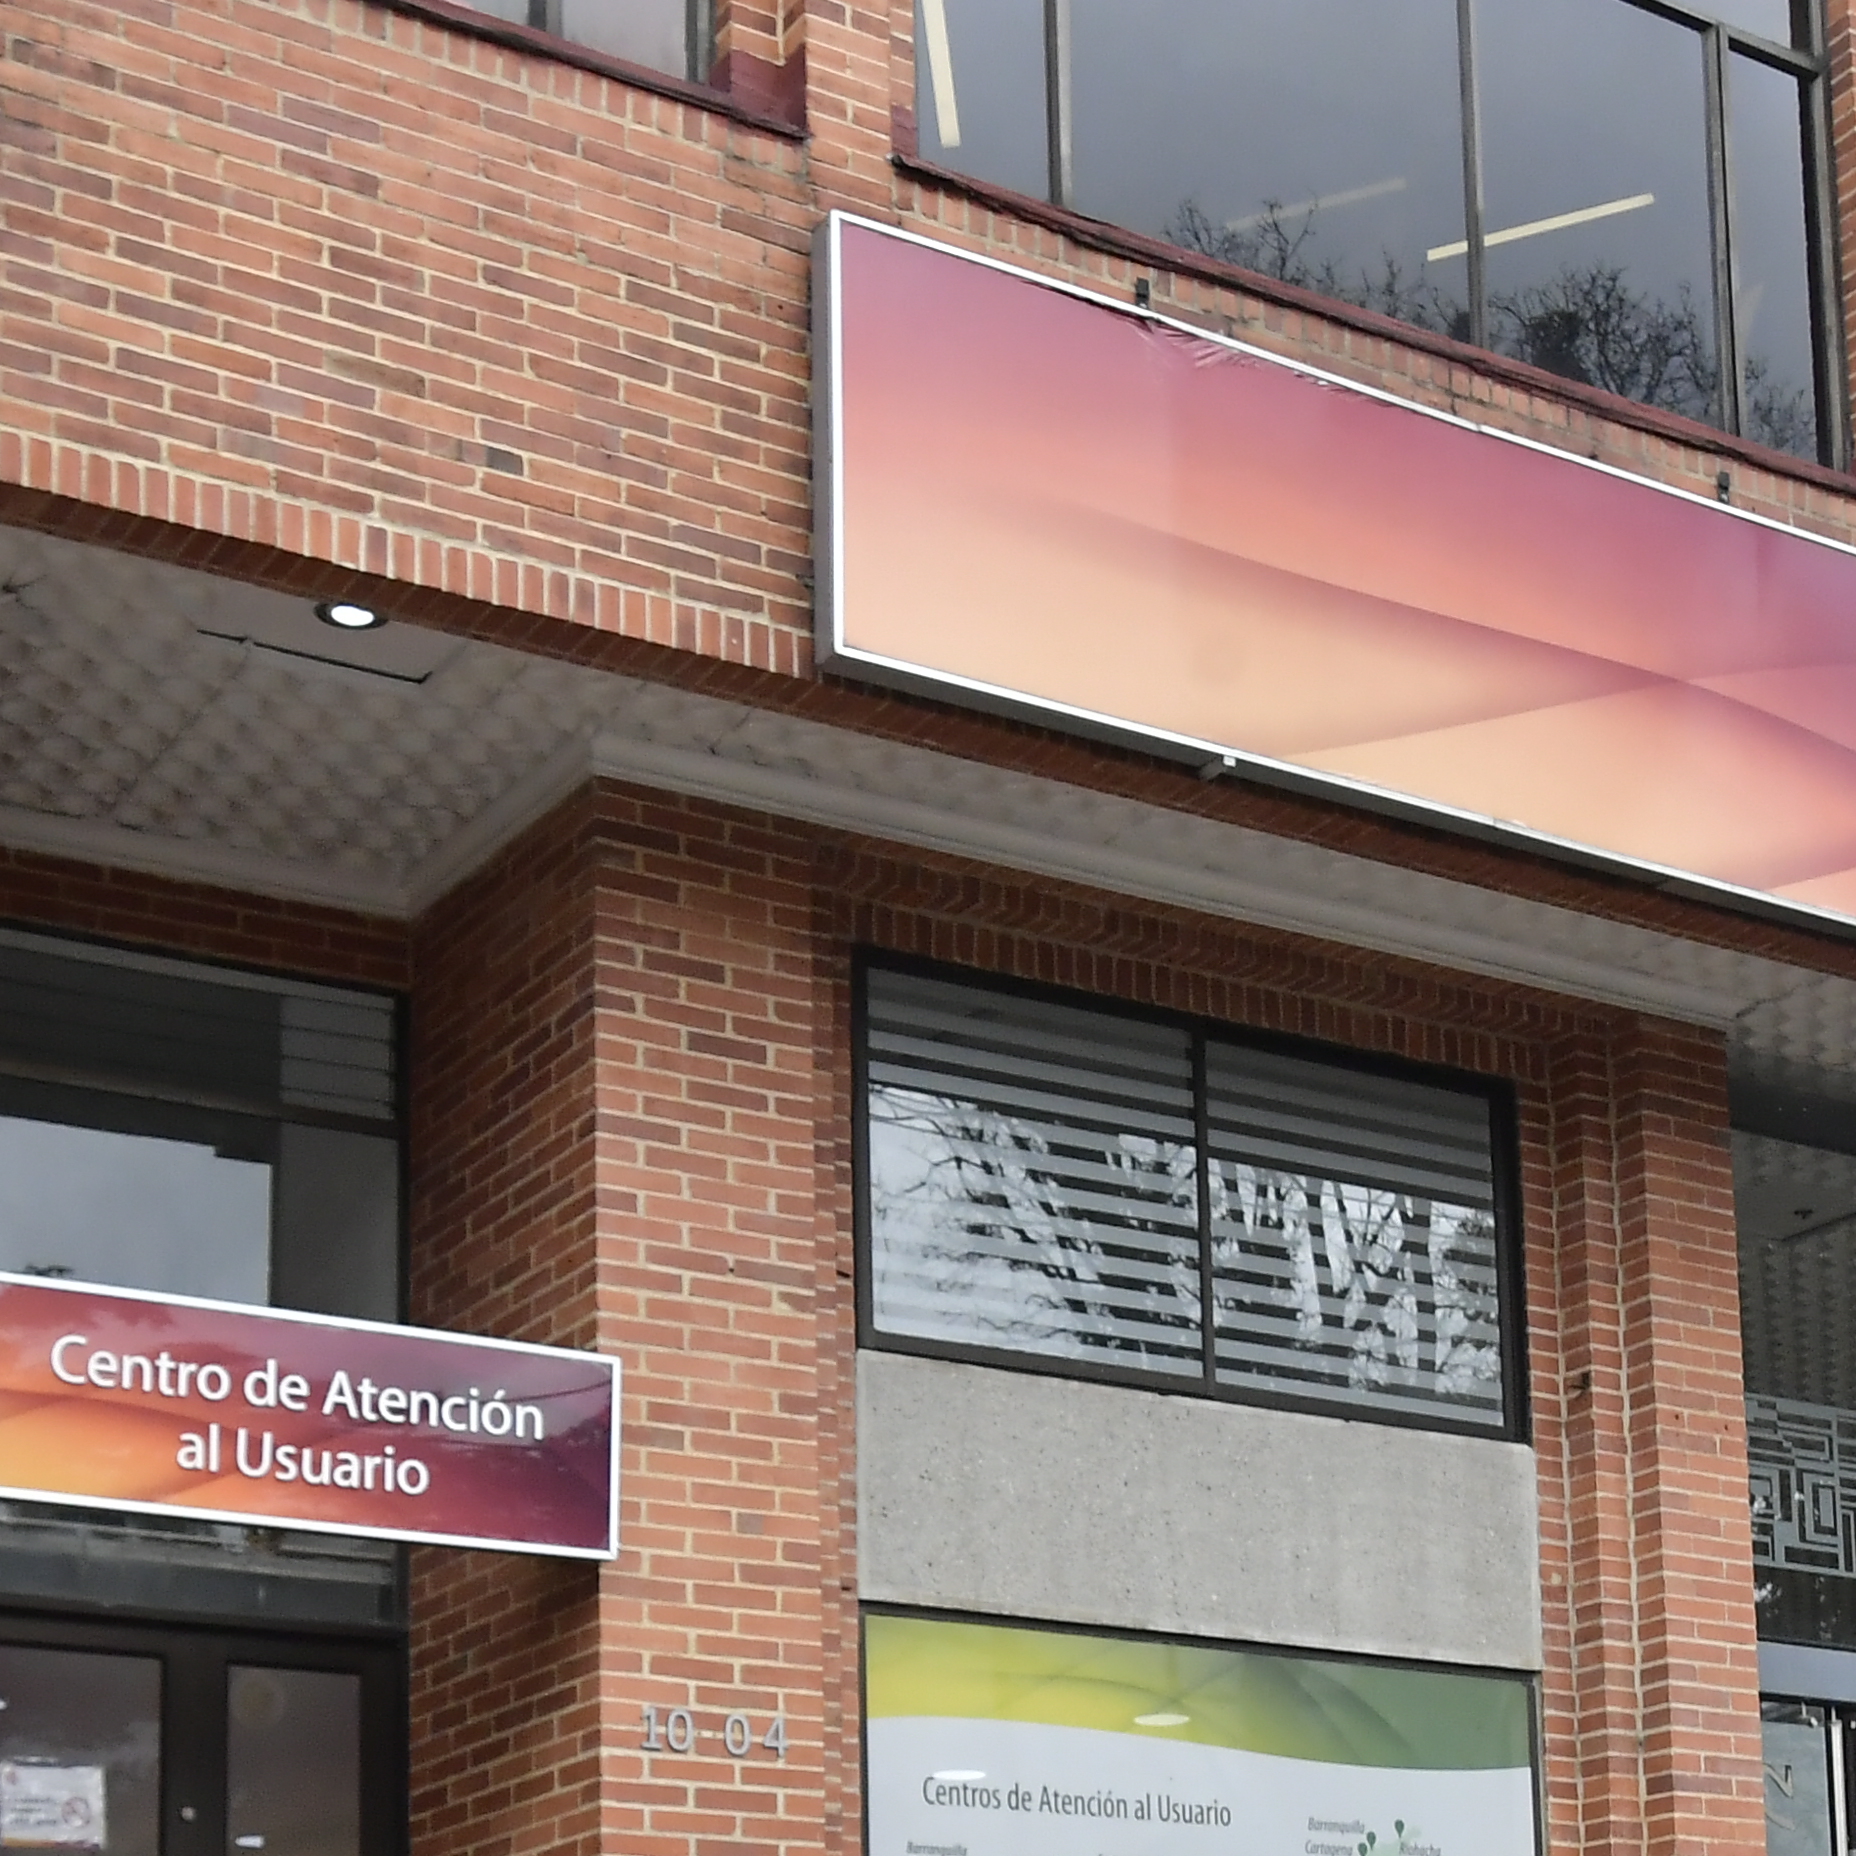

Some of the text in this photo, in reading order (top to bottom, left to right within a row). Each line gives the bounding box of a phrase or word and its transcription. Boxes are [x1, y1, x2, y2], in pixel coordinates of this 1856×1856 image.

[50, 1335, 544, 1441] Centro de Atención
[176, 1423, 430, 1496] al Usuario
[921, 1775, 1232, 1828] Centros de Atención al Usuario
